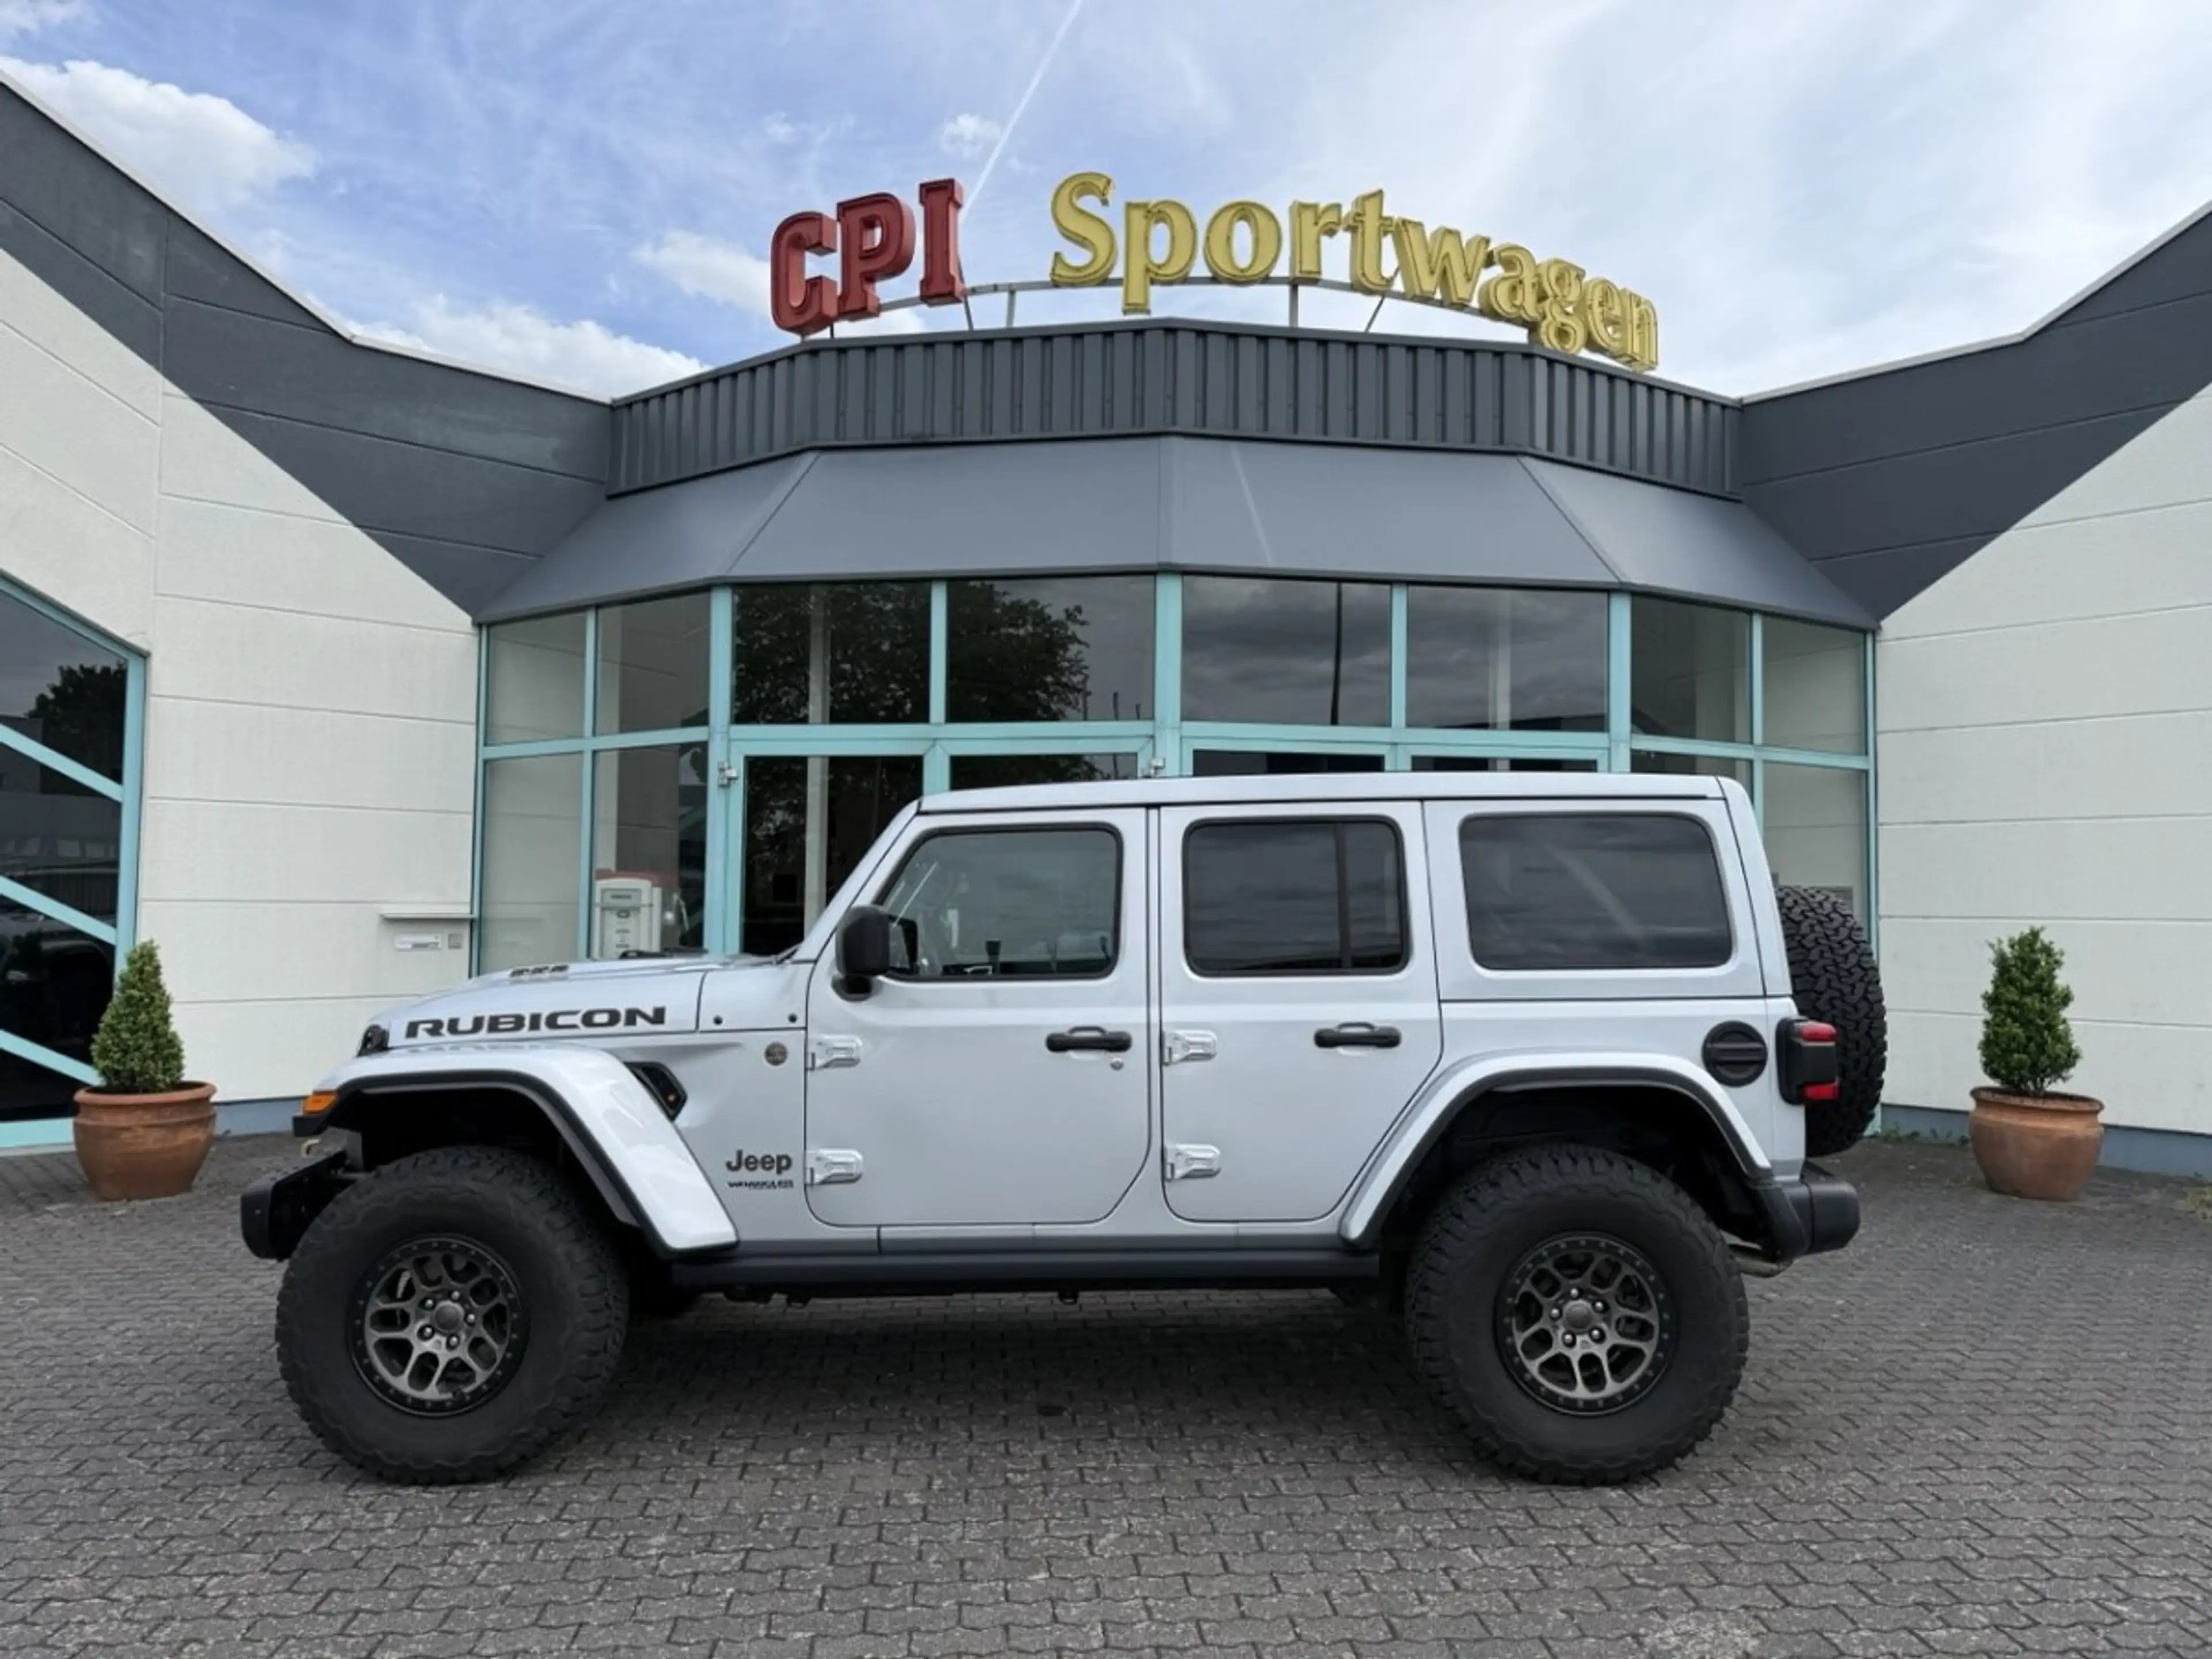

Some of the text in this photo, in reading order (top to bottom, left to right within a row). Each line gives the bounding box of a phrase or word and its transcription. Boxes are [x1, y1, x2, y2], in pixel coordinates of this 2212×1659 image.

[771, 172, 1658, 372] CPI Sportwagen
[406, 1006, 666, 1039] RUBICON
[726, 1149, 793, 1175] Jeep
